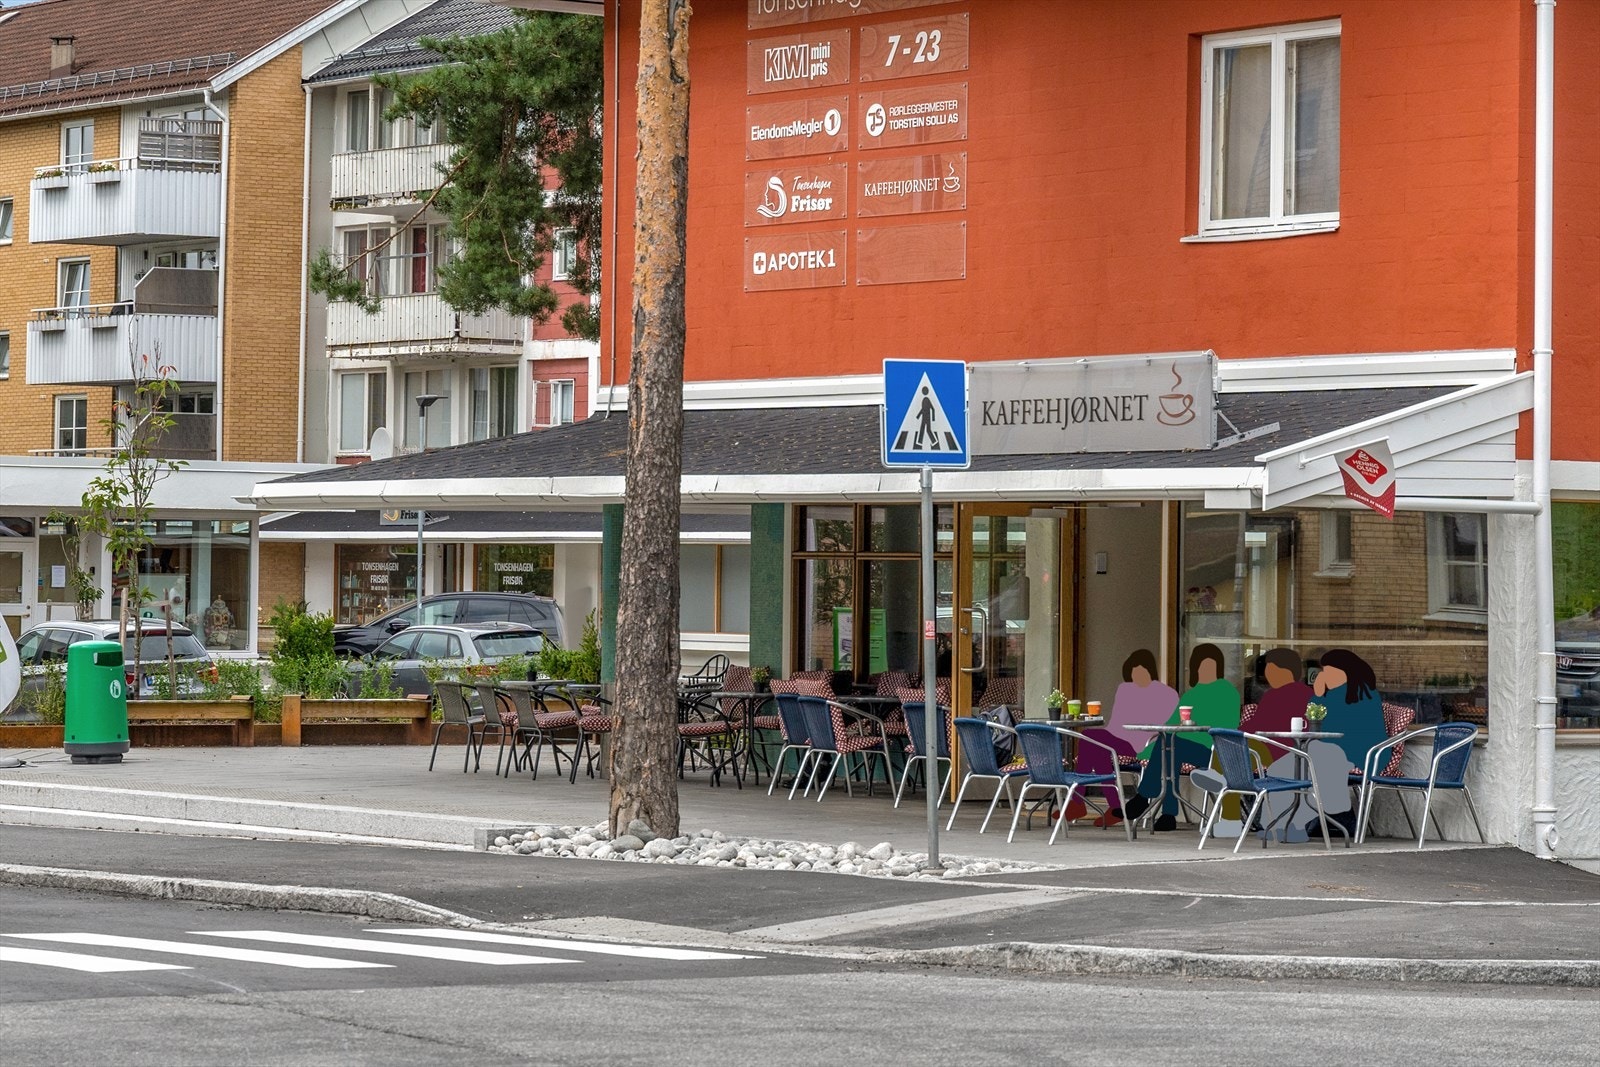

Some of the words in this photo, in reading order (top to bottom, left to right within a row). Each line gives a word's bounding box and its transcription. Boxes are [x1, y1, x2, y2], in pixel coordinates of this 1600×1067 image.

[811, 41, 831, 60] mini
[764, 44, 809, 82] KIWI
[810, 60, 828, 80] pris
[889, 100, 958, 117] RØRLEGGERMESTER
[751, 118, 824, 141] EiendomsMegler
[889, 116, 925, 130] TORSTEIN
[925, 114, 947, 127] SOLLI
[947, 112, 959, 125] AS
[864, 177, 940, 197] KAFFEHJØRNET
[790, 195, 833, 212] Frisør
[767, 250, 828, 272] APOTEK
[827, 248, 836, 267] 1
[981, 394, 1149, 430] KAFFEHJØRNET
[361, 562, 399, 571] TONSENHAGEN
[493, 562, 534, 572] TONSENHAGEN
[370, 574, 389, 584] FRISØR
[502, 575, 523, 585] FRISØR
